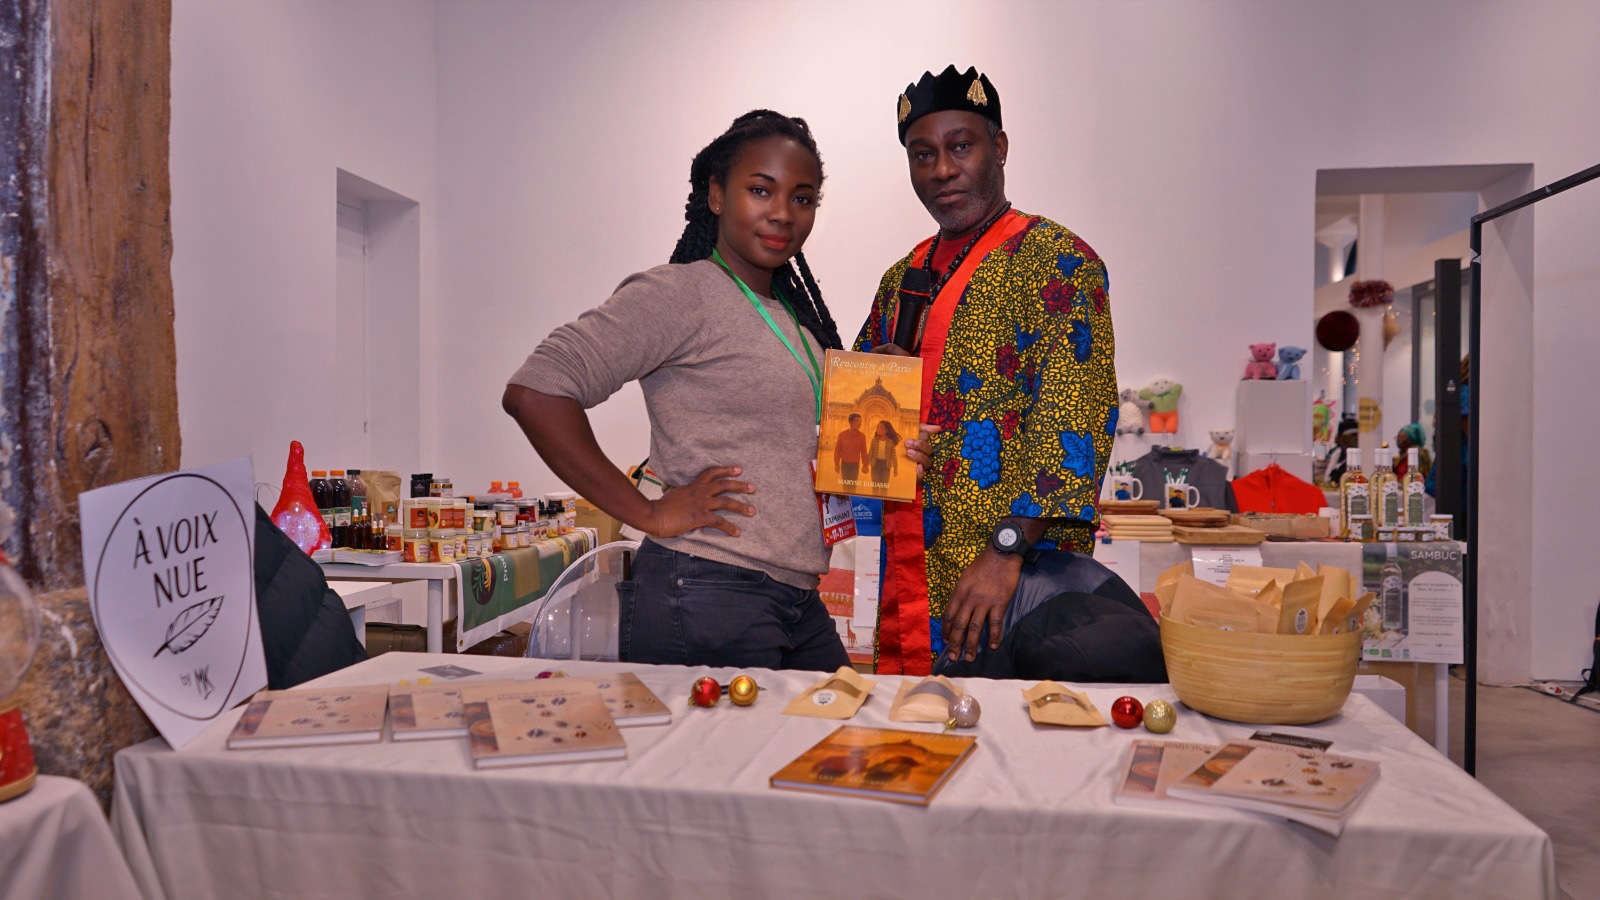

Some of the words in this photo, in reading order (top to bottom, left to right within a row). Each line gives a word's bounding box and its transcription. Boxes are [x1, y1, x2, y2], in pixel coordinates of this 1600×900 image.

[831, 356, 877, 370] Rencontre
[879, 361, 885, 371] à
[887, 361, 912, 373] Paris
[837, 478, 863, 487] MARYSE
[863, 480, 890, 489] KOUASSI
[825, 510, 850, 526] EXPOSANT
[133, 516, 152, 570] À
[156, 510, 218, 560] VOIX
[1410, 550, 1457, 561] SAMBUC
[153, 556, 207, 608] NUE
